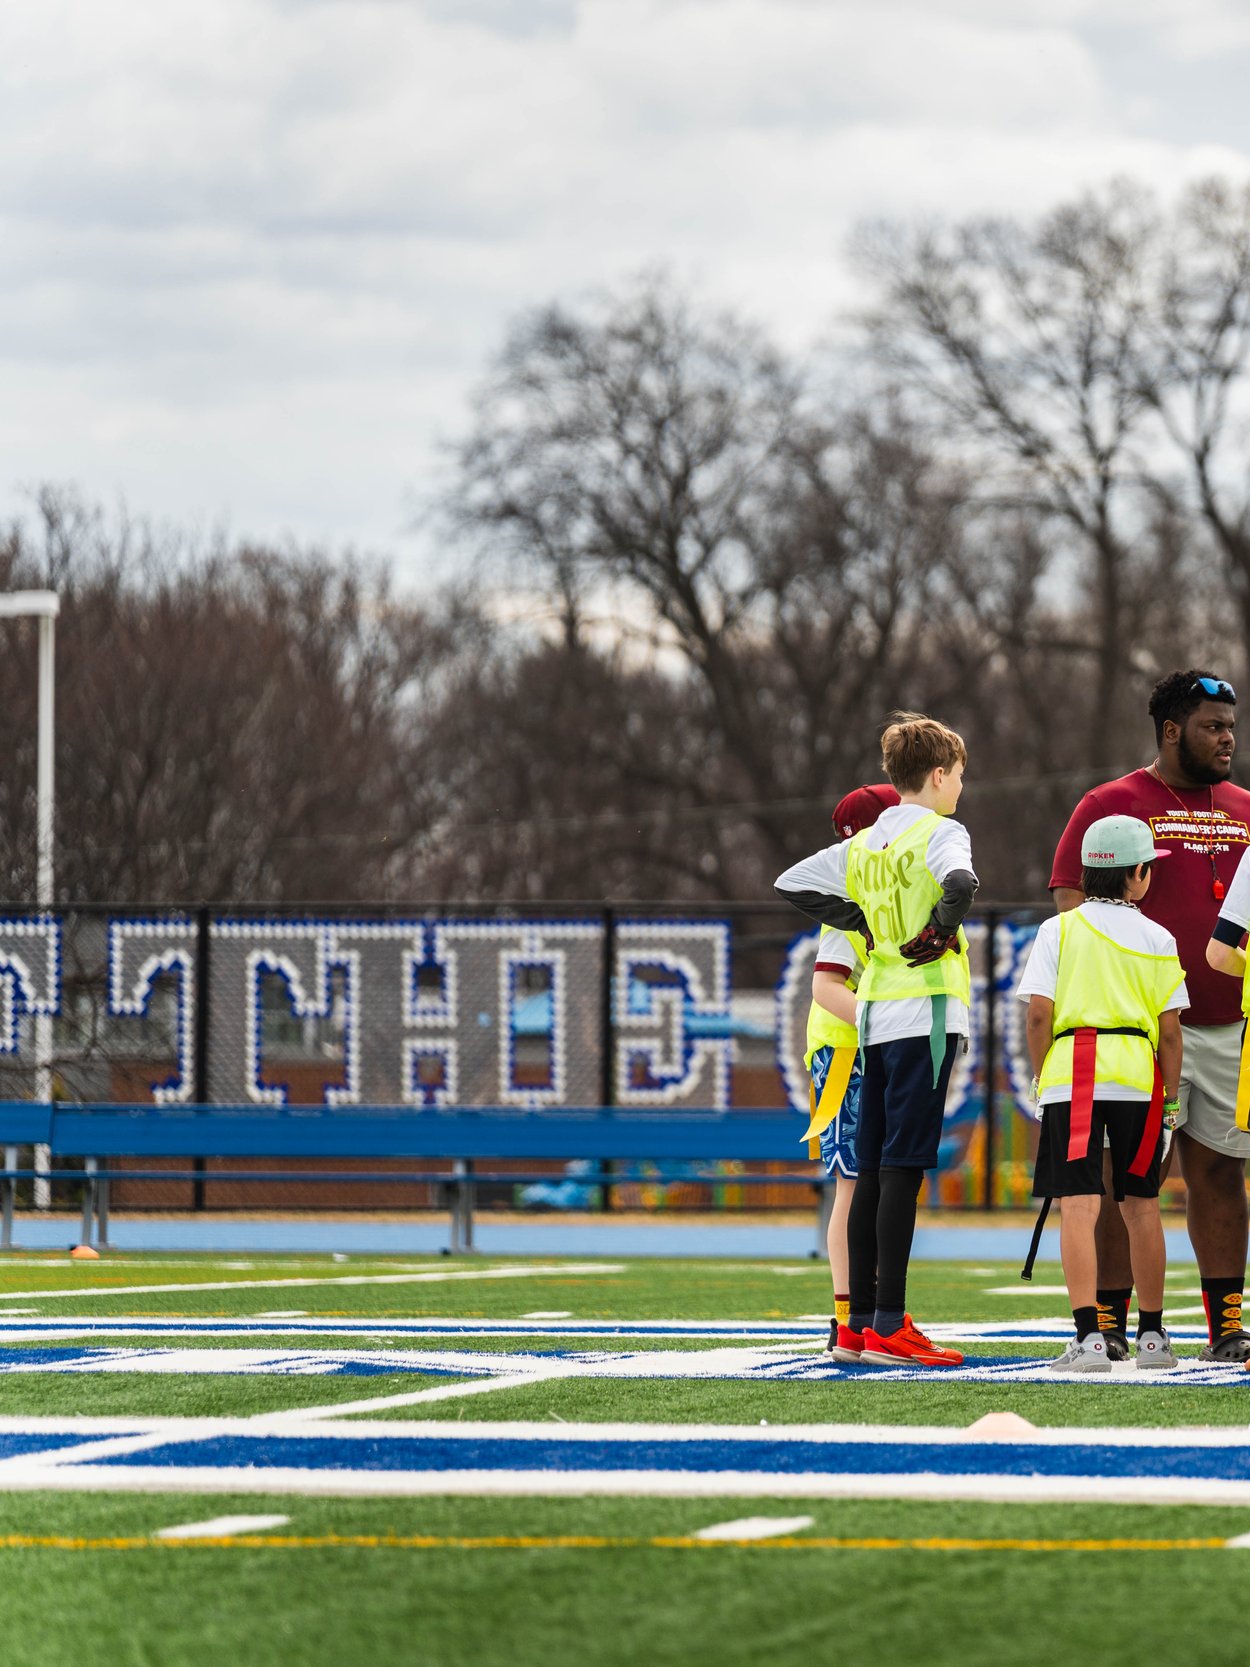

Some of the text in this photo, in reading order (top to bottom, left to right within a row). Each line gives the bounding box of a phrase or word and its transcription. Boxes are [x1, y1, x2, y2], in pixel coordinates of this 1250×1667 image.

[1155, 823, 1247, 837] COMMANDERS CAMPS
[108, 914, 733, 1111] THE
